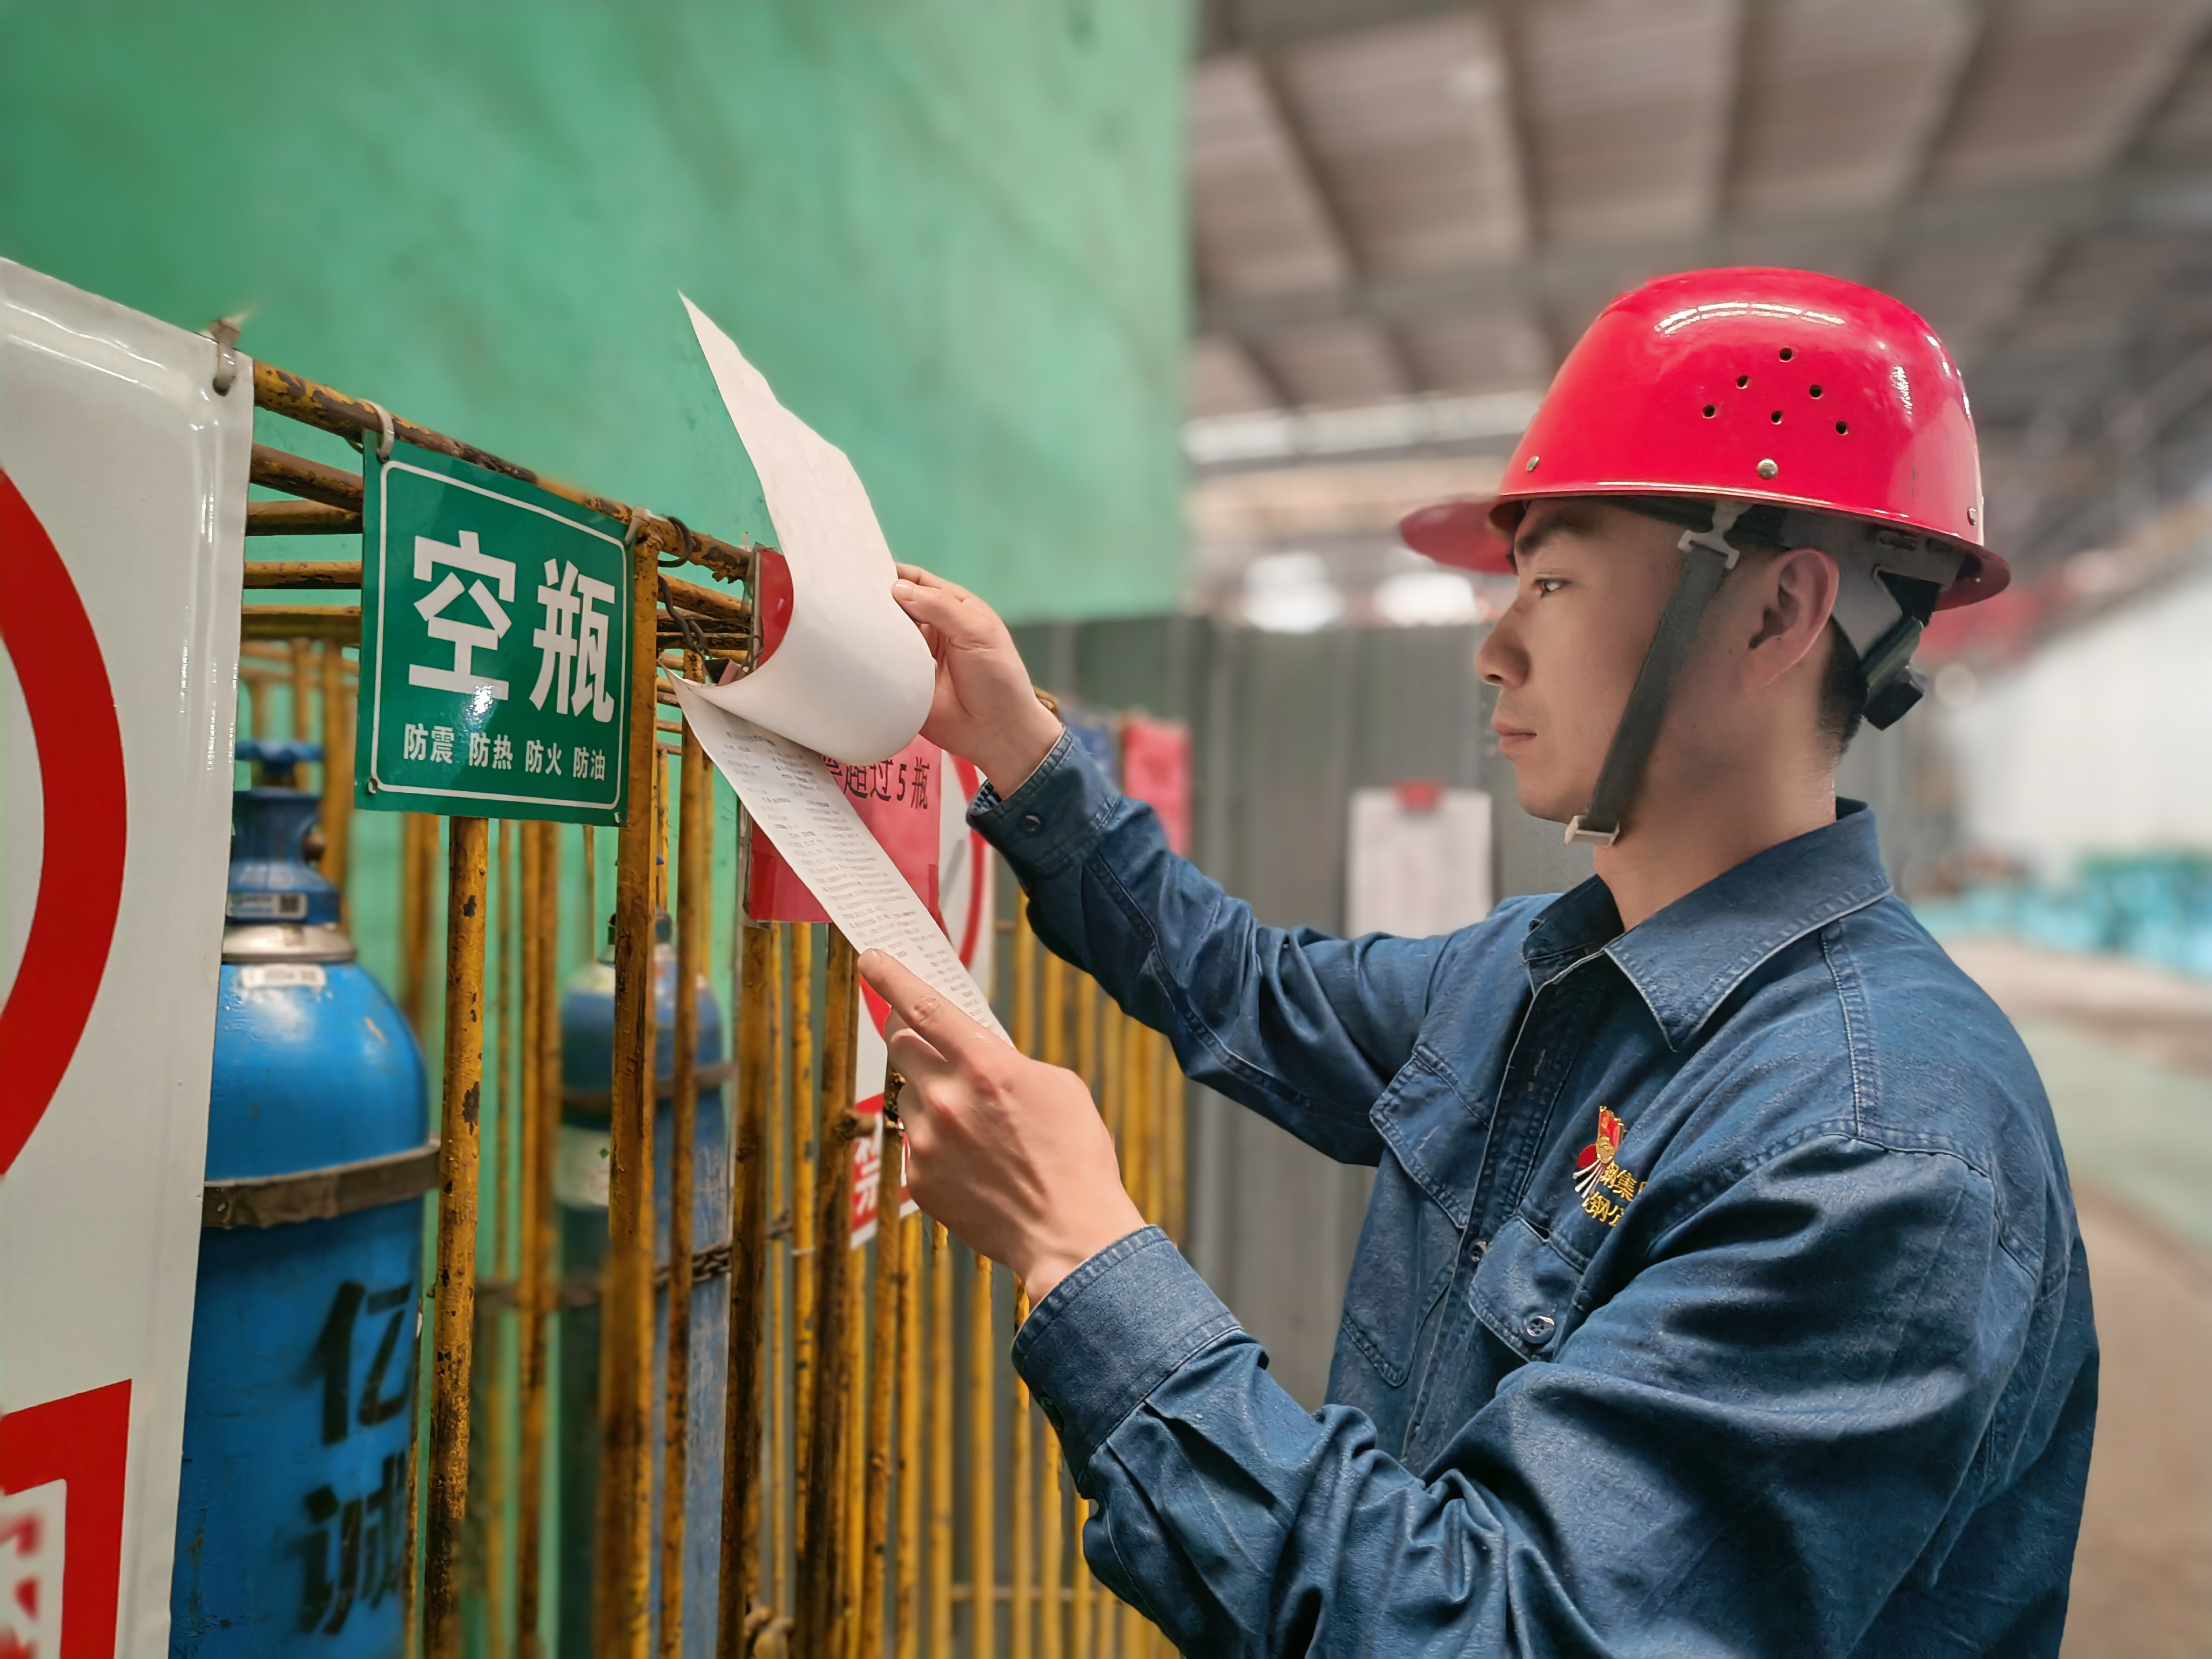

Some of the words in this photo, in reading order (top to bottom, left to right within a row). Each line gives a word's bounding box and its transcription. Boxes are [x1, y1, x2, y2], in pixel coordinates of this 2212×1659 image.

[409, 530, 616, 723] 空瓶
[403, 723, 455, 764] 防震
[469, 732, 513, 770] 防热
[525, 740, 562, 775] 防火
[572, 746, 605, 781] 防油
